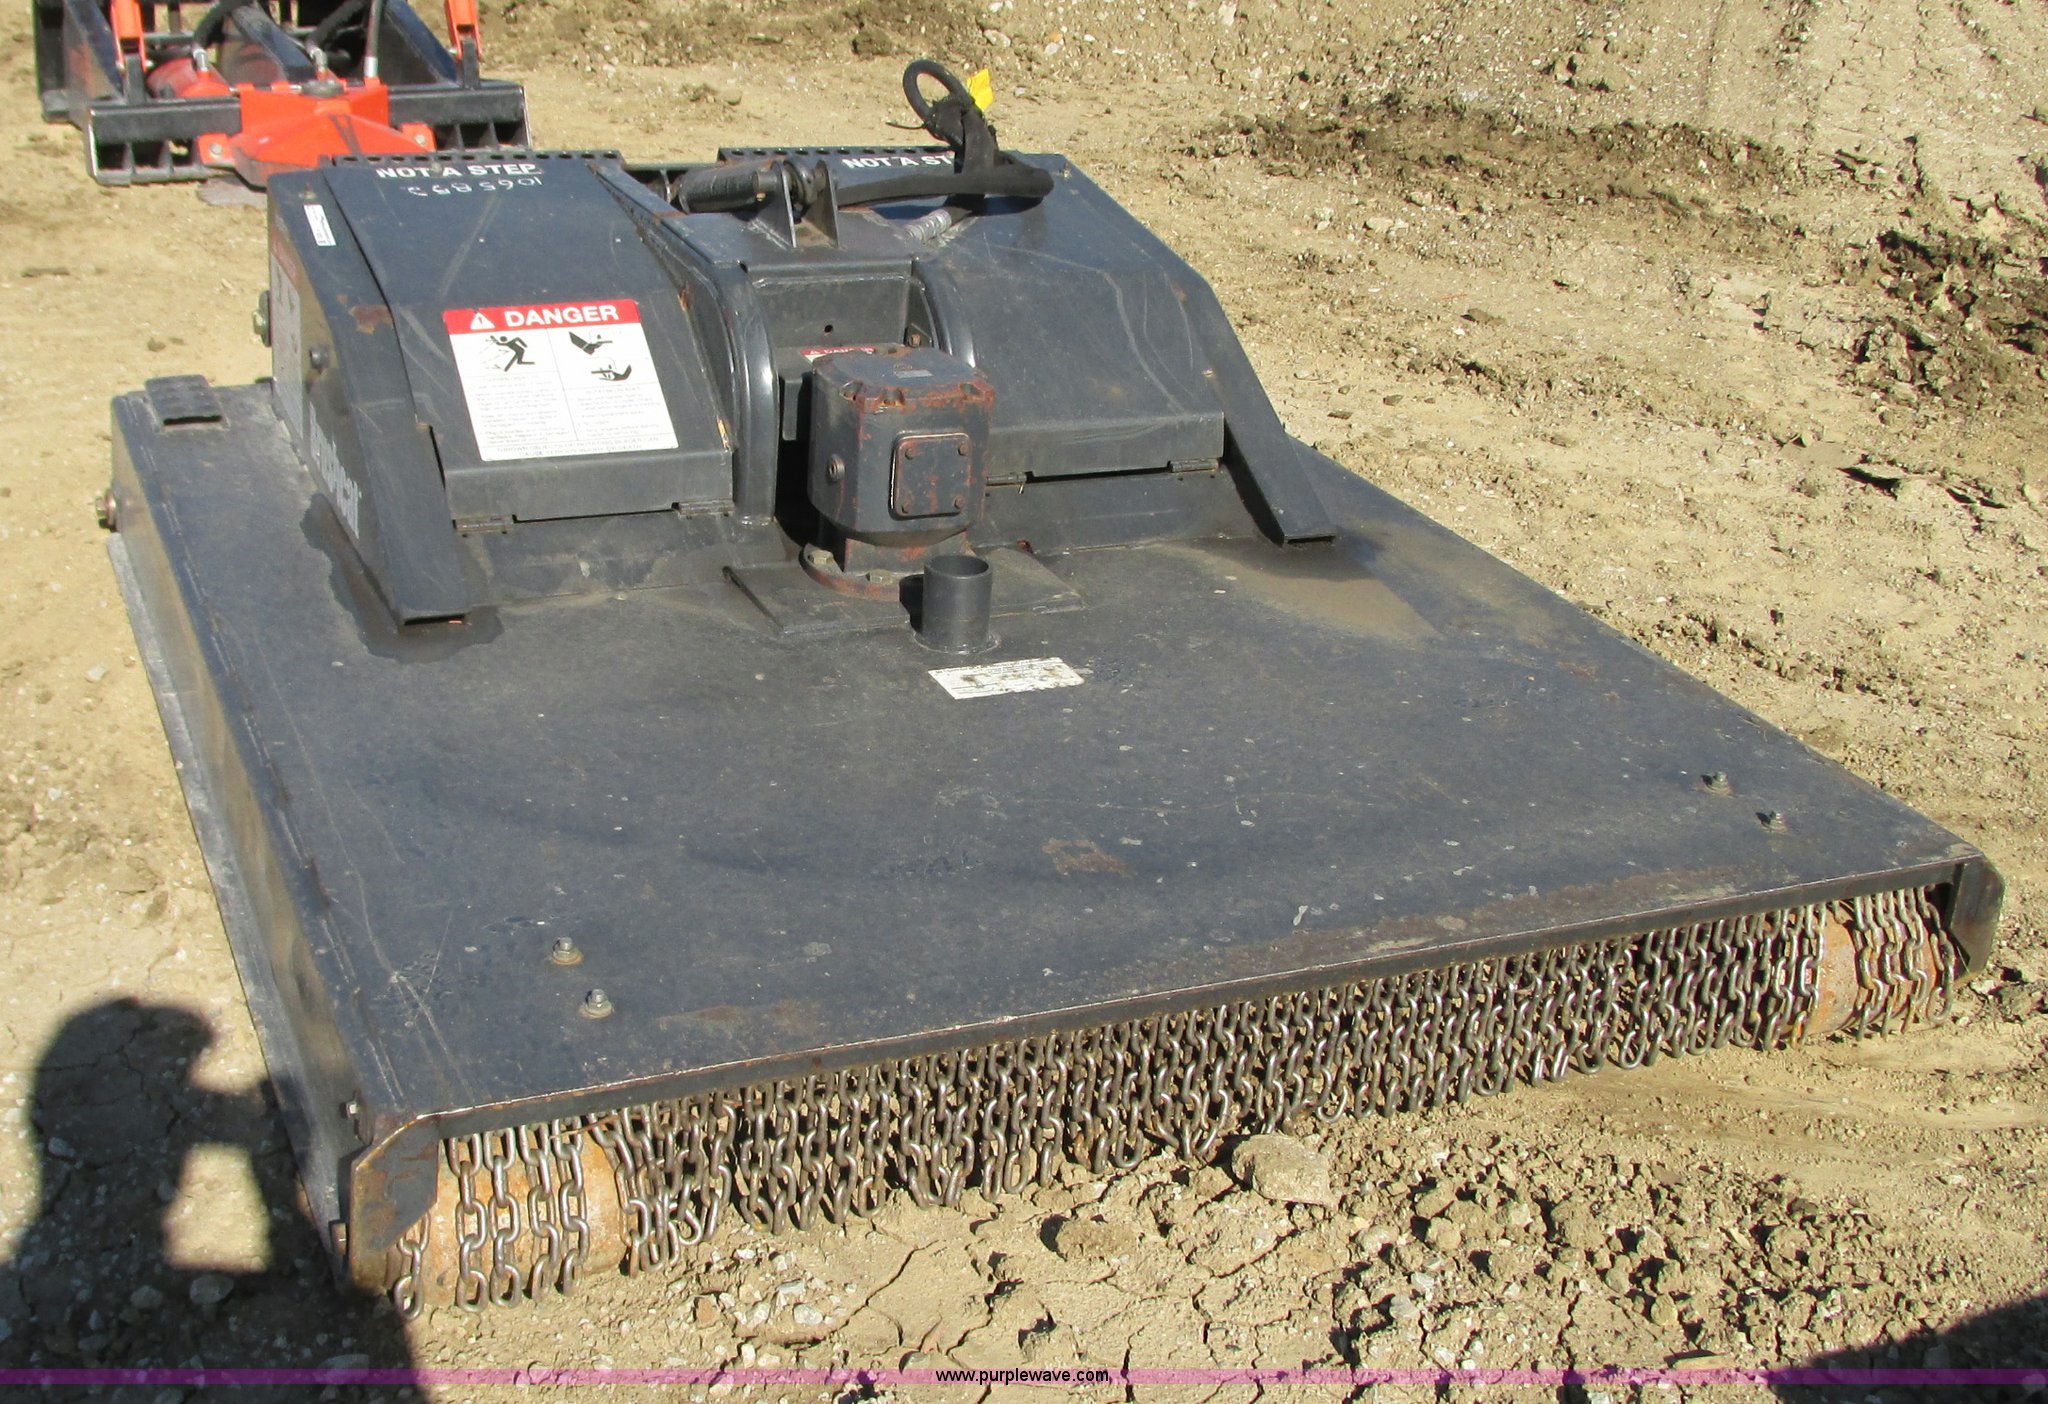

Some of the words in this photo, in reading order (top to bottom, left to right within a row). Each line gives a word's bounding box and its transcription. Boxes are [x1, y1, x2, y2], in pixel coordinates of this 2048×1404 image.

[842, 157, 892, 168] NOT
[900, 157, 919, 166] A
[921, 155, 953, 165] ST
[375, 167, 431, 178] NOT
[442, 167, 463, 177] A
[467, 163, 541, 176] STEP
[504, 304, 620, 327] DANGER
